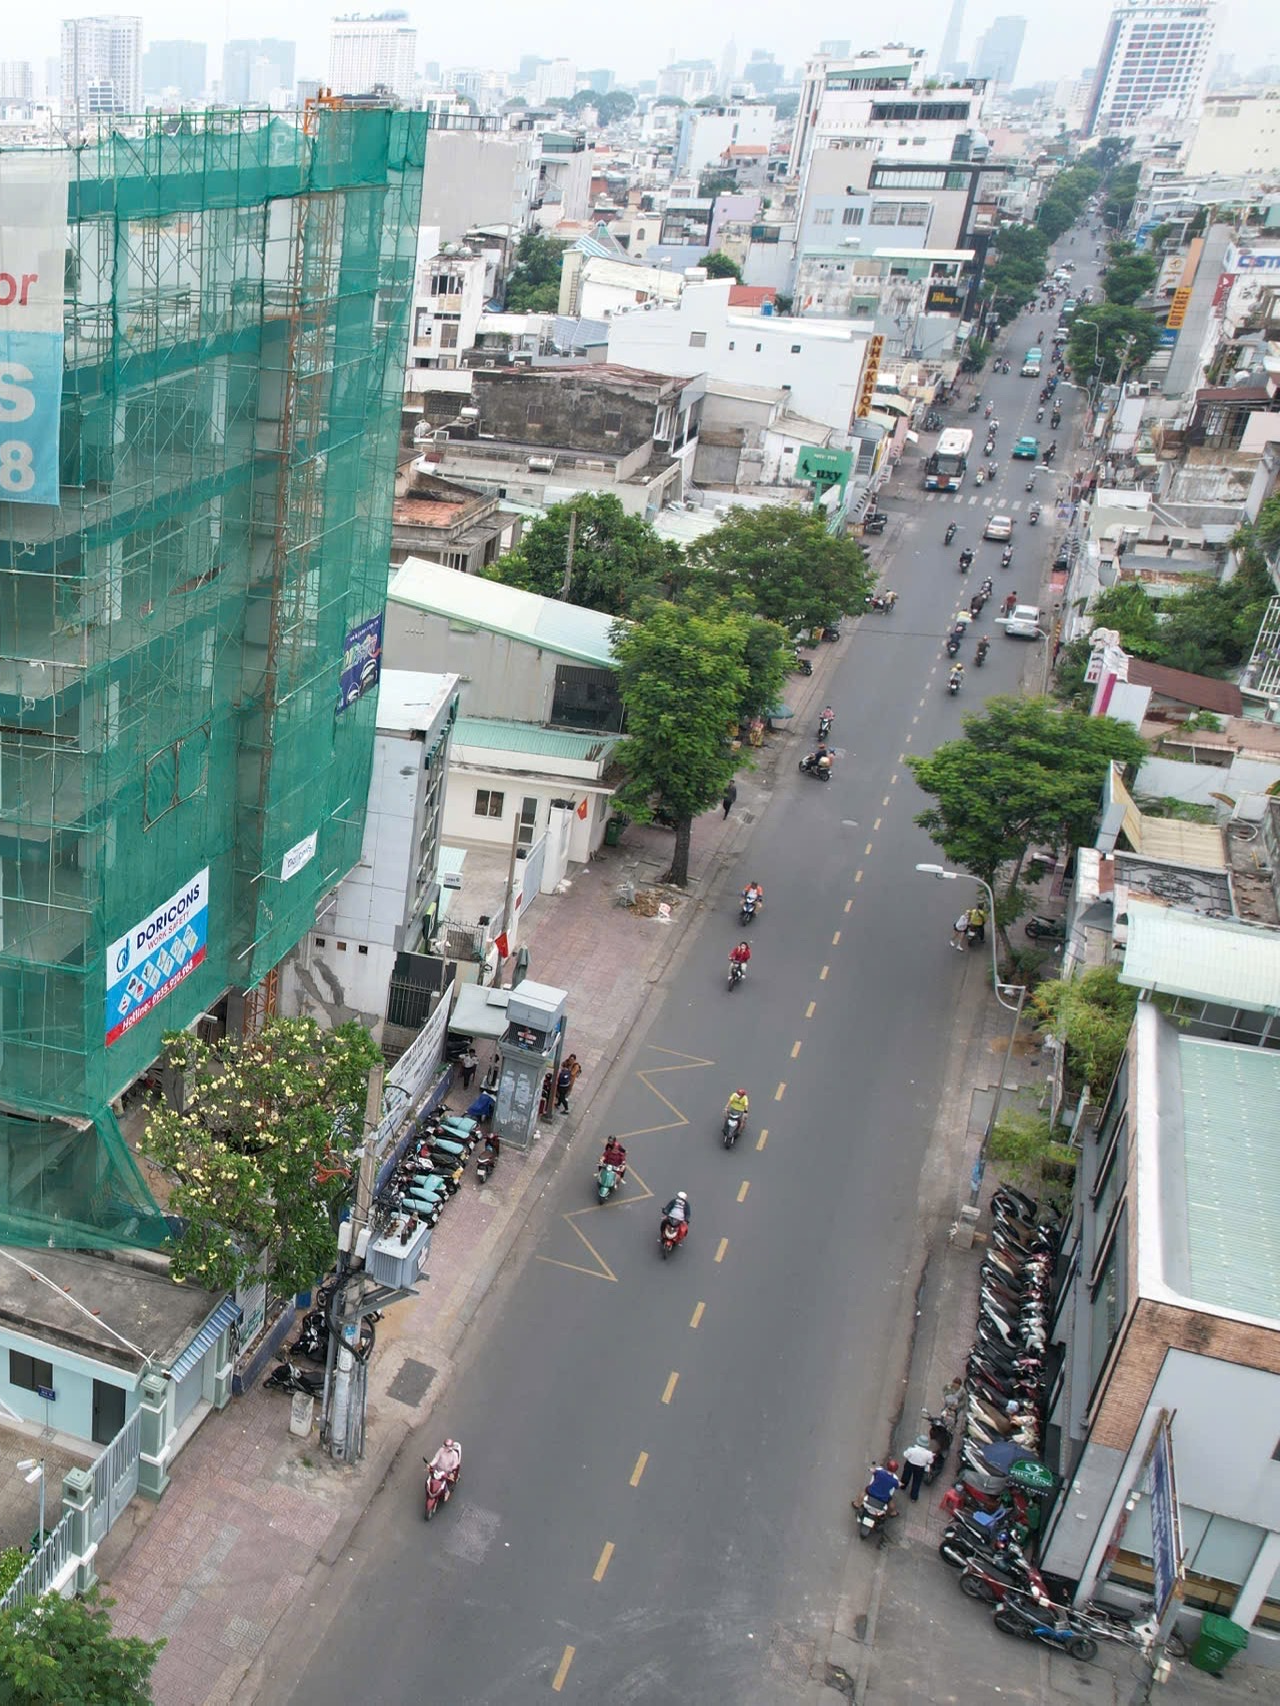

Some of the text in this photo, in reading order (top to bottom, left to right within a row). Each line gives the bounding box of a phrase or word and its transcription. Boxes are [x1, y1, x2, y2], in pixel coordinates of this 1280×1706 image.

[136, 884, 200, 949] DORICONS
[147, 911, 190, 951] WORK SAFETY
